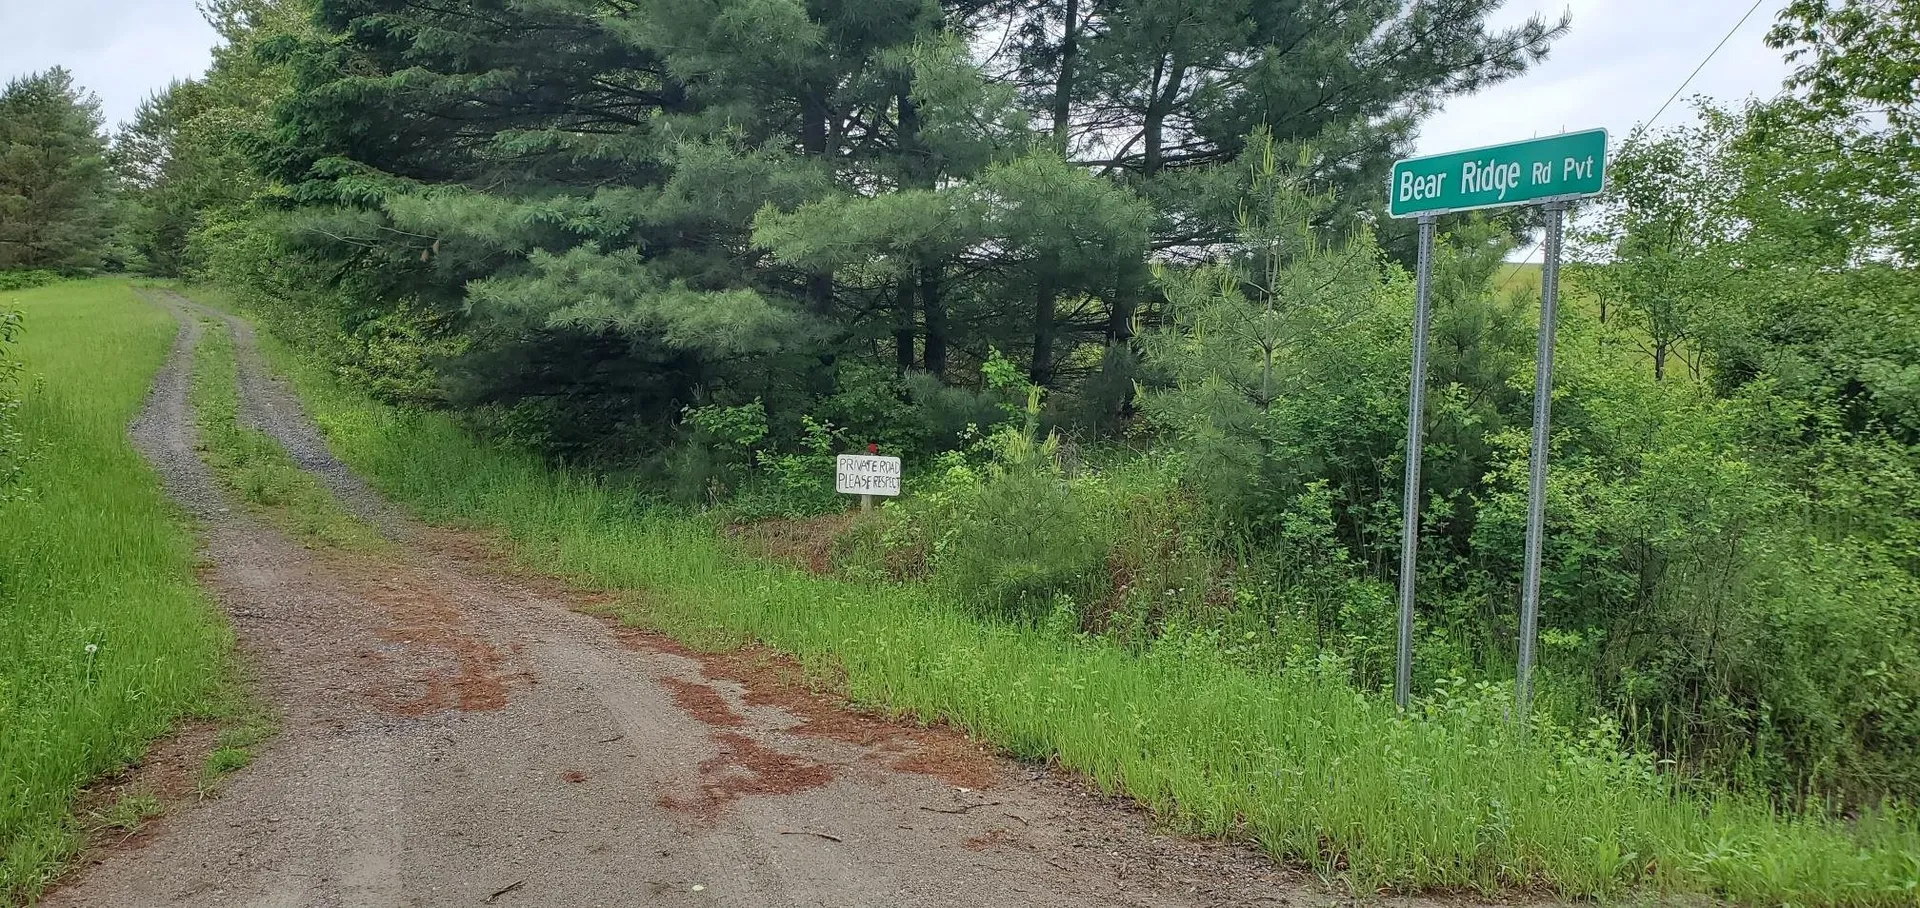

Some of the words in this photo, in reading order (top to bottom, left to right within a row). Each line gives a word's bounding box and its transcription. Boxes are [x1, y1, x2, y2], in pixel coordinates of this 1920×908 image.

[1400, 171, 1447, 202] Bear
[1461, 158, 1521, 200] Ridge
[1532, 161, 1551, 185] Rd
[1563, 155, 1594, 181] Pvt
[840, 459, 877, 472] PRIVATE
[880, 460, 900, 474] ROAD
[838, 473, 872, 489] PLEASE
[873, 476, 900, 489] RESPECT
